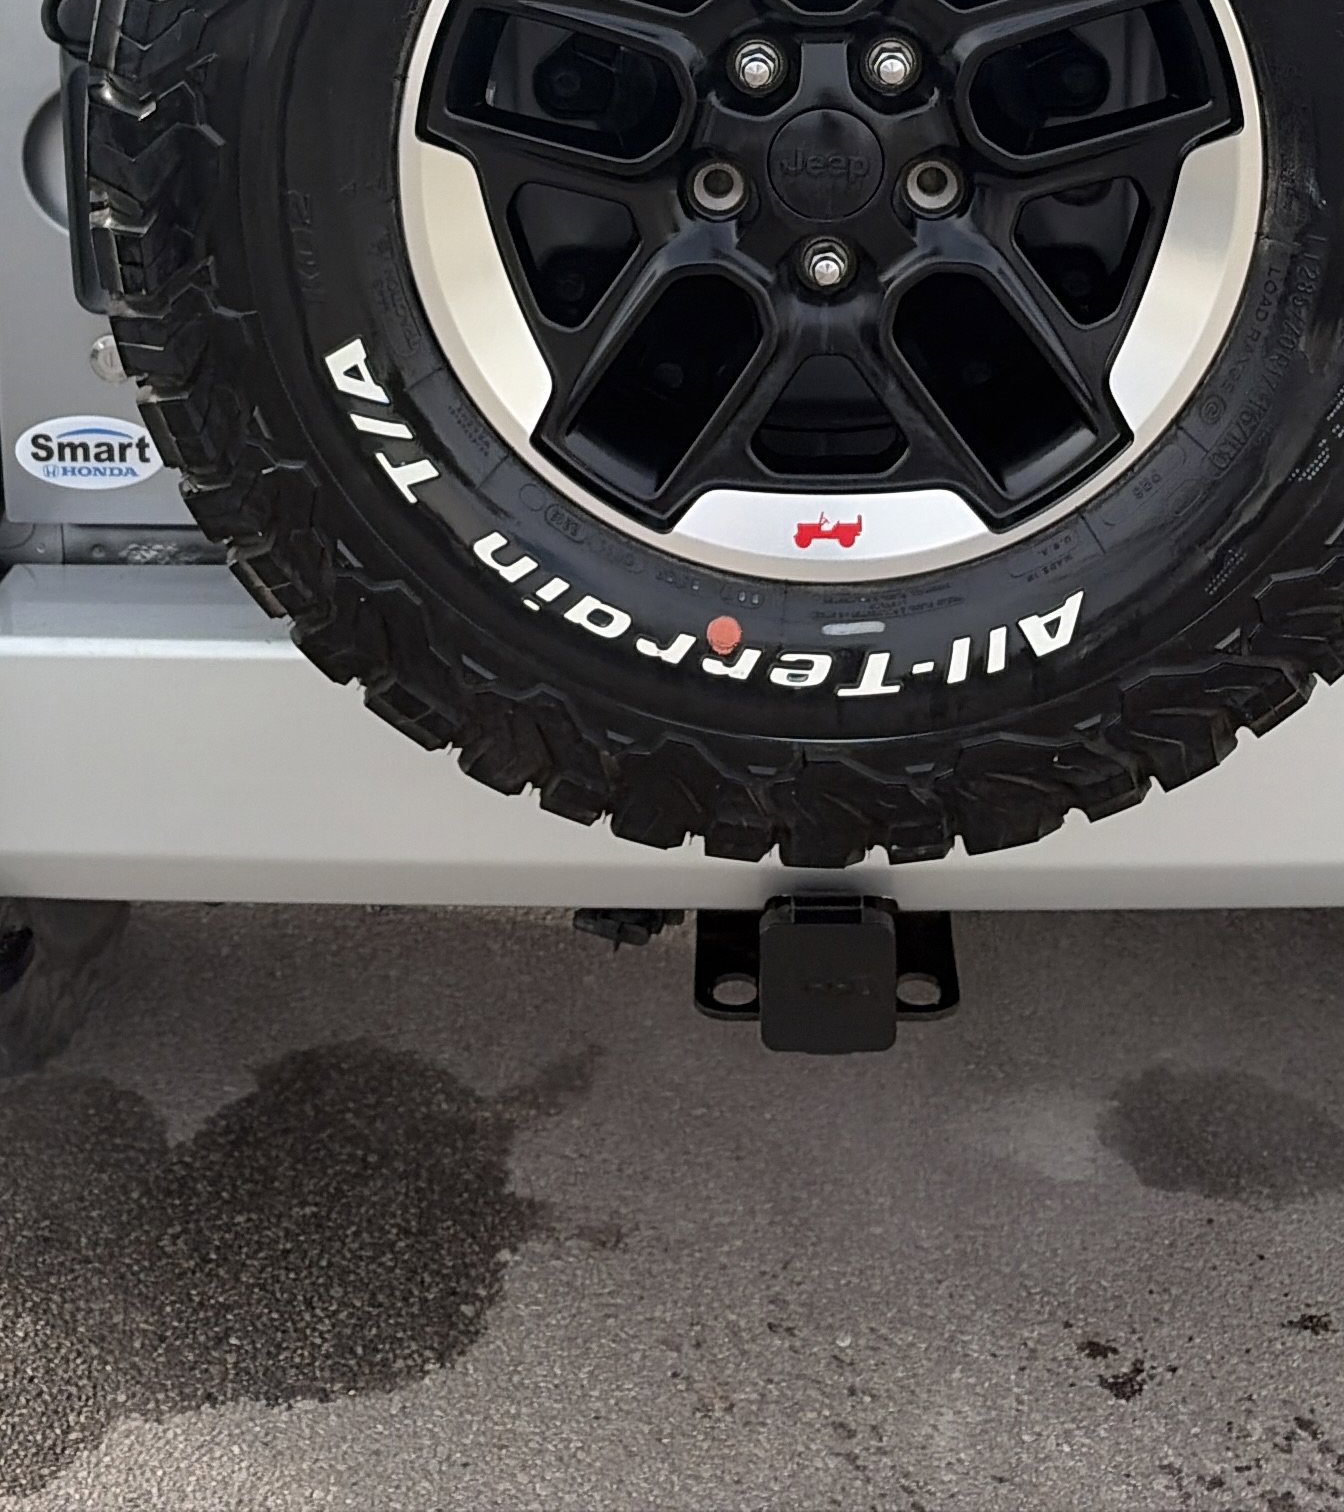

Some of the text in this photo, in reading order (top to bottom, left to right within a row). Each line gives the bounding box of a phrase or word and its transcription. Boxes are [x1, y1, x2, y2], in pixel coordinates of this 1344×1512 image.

[779, 149, 870, 183] Jeep
[324, 338, 439, 504] T/A
[31, 433, 152, 463] Smart
[61, 465, 140, 478] HONDA
[472, 531, 1084, 697] All-Terrain
